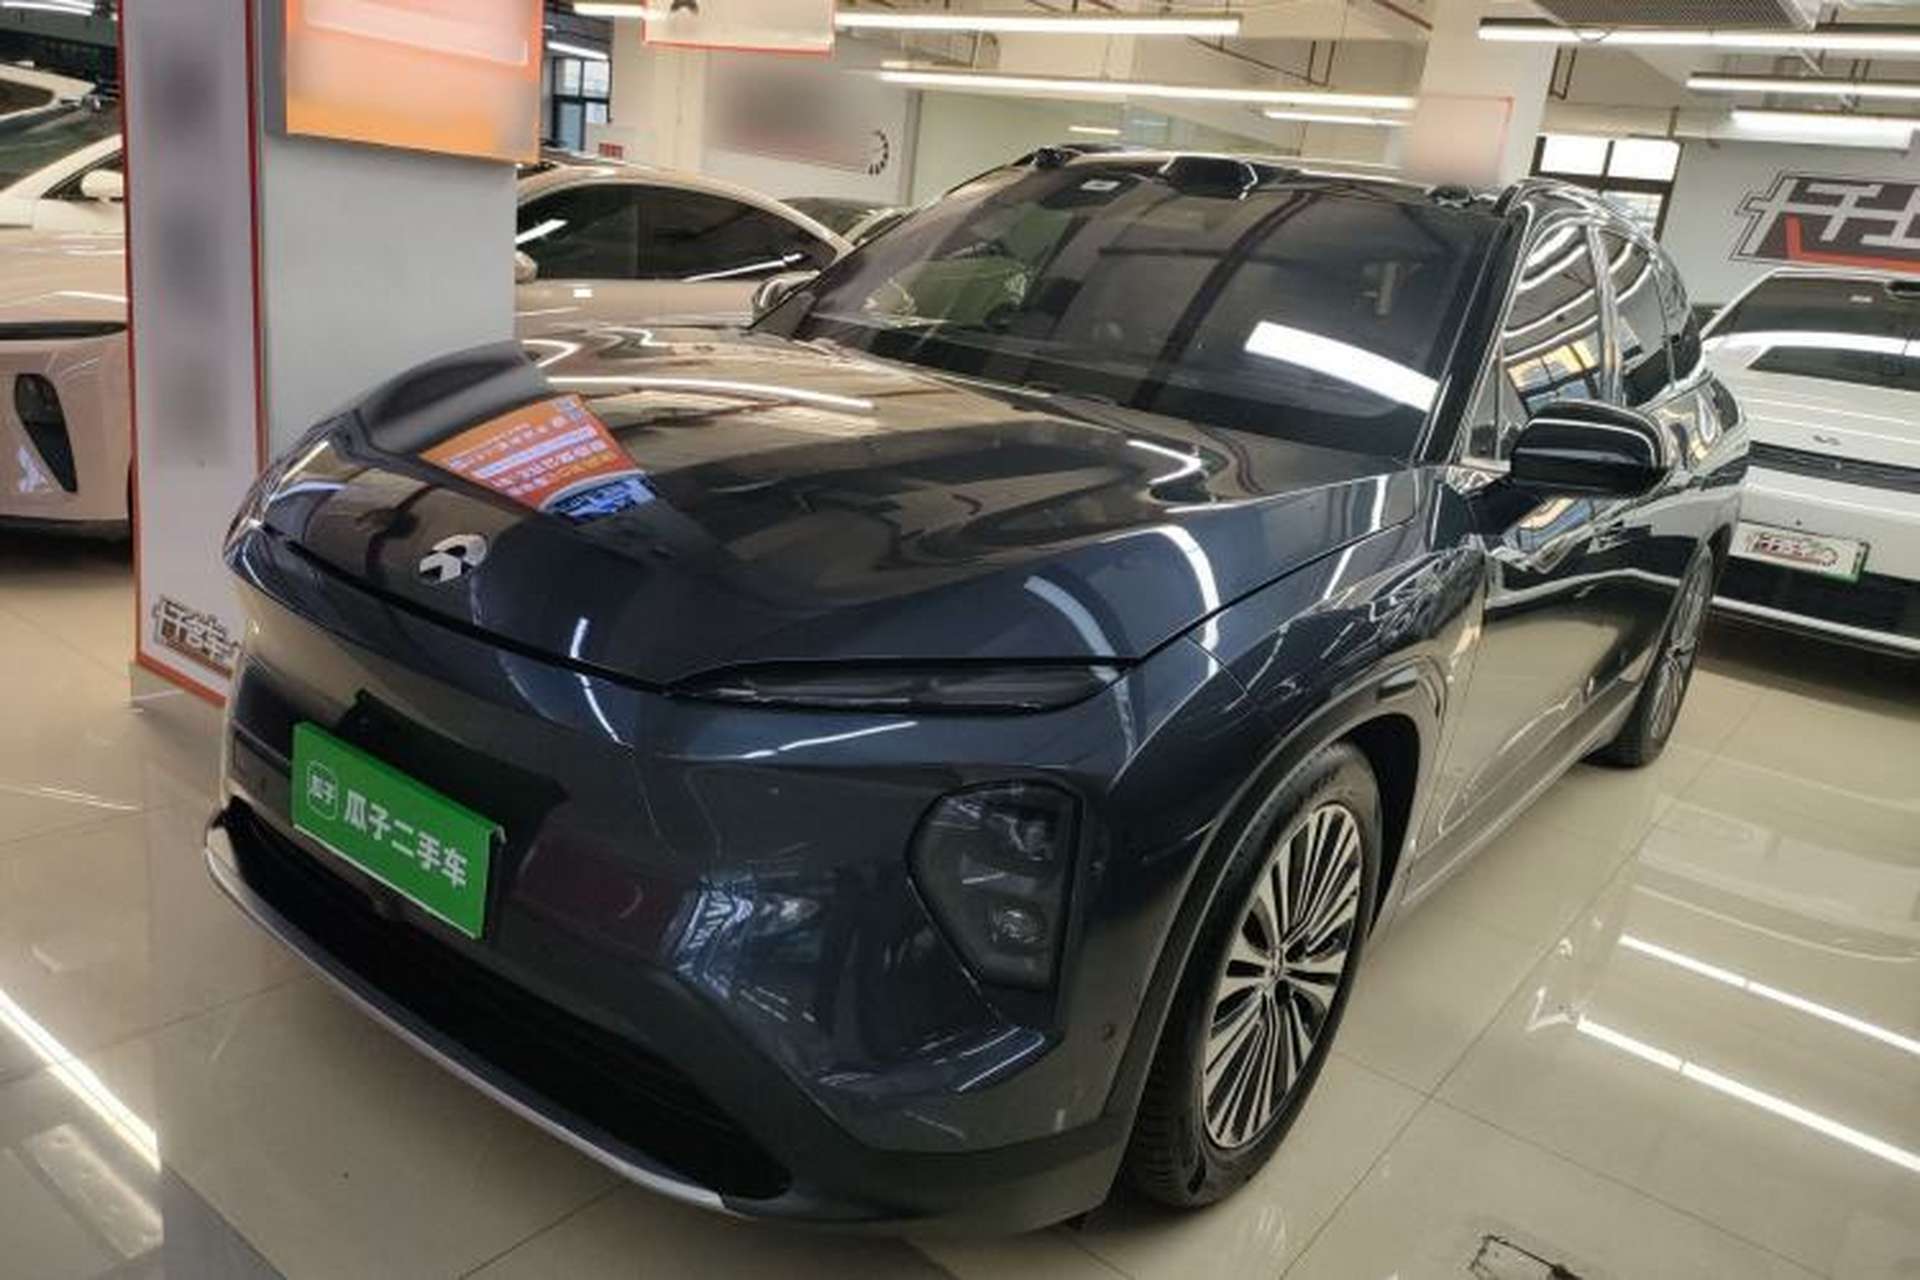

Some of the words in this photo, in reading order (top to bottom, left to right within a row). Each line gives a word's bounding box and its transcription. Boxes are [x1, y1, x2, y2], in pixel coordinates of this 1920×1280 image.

[344, 788, 468, 888] 瓜子二手车
